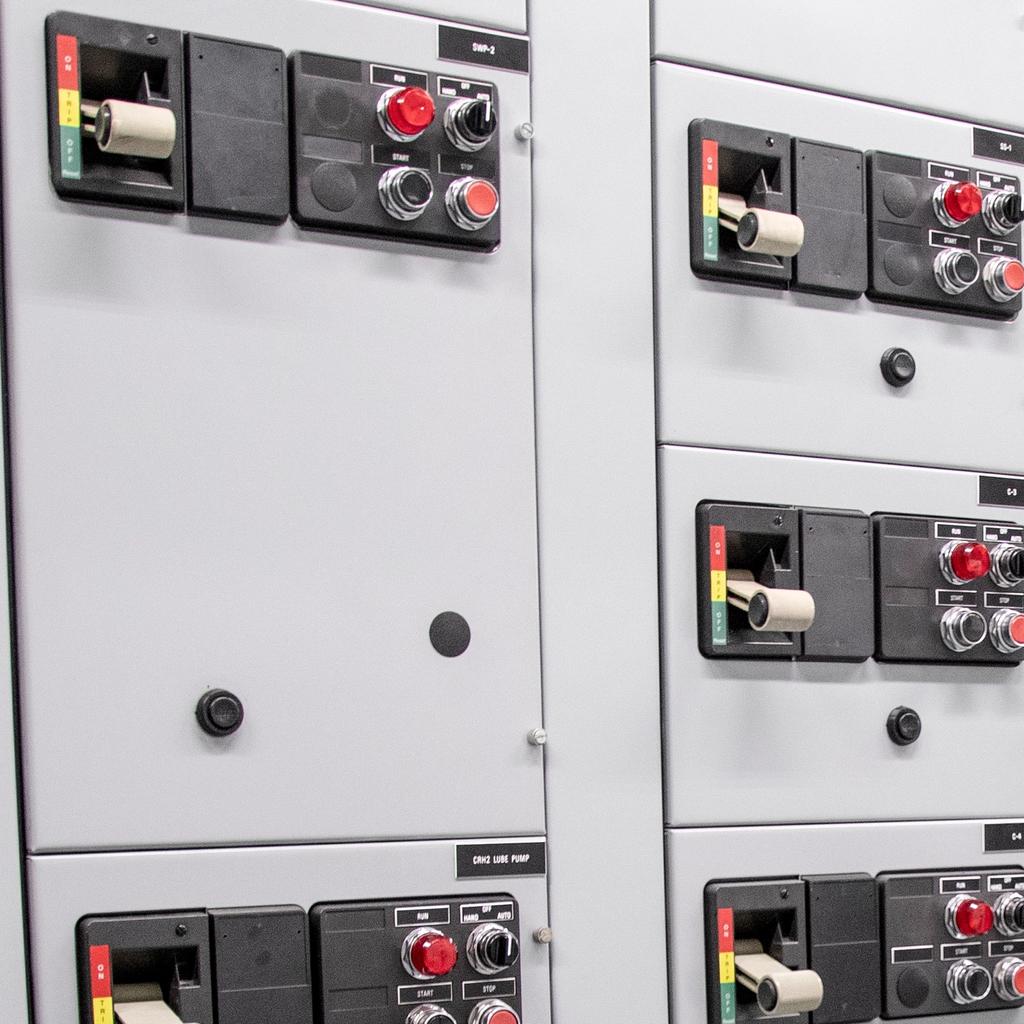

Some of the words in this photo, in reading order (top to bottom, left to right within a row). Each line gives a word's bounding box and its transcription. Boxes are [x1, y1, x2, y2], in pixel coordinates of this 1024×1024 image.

[473, 42, 495, 54] SWP-2
[64, 56, 71, 72] ON
[393, 154, 409, 162] START
[473, 855, 490, 864] CRH2
[493, 855, 509, 864] LUBE
[511, 854, 529, 863] PUMP
[417, 912, 428, 920] RUN
[464, 914, 479, 922] HAND
[498, 912, 511, 920] AUTO
[97, 964, 104, 980] ON
[417, 990, 433, 998] START
[483, 985, 495, 993] STOP
